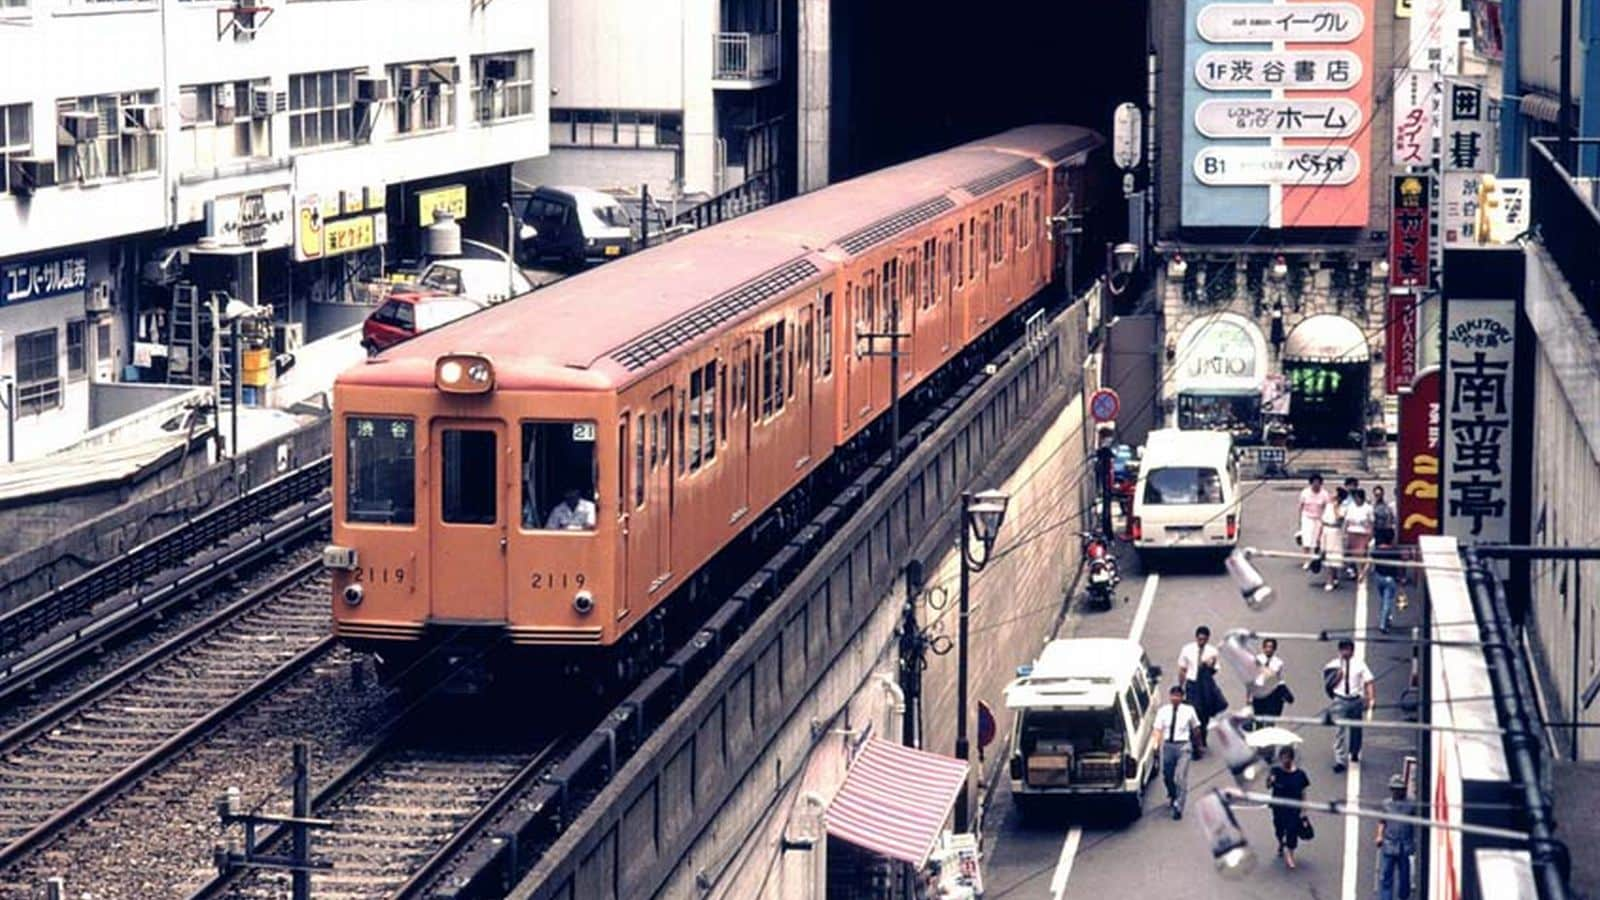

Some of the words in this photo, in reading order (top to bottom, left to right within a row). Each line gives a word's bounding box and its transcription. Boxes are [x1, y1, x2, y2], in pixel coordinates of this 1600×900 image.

[1276, 13, 1348, 32] イーグル
[1231, 60, 1349, 82] 渋谷書店
[1277, 106, 1346, 128] ホーム
[1450, 84, 1481, 169] 囲碁
[1204, 157, 1226, 174] B1
[1448, 318, 1513, 343] YAKITORI
[357, 420, 408, 439] 渋谷
[575, 424, 593, 438] 21
[1450, 351, 1509, 535] 南蛮亭
[353, 566, 404, 583] 2119
[531, 572, 586, 589] 2119
